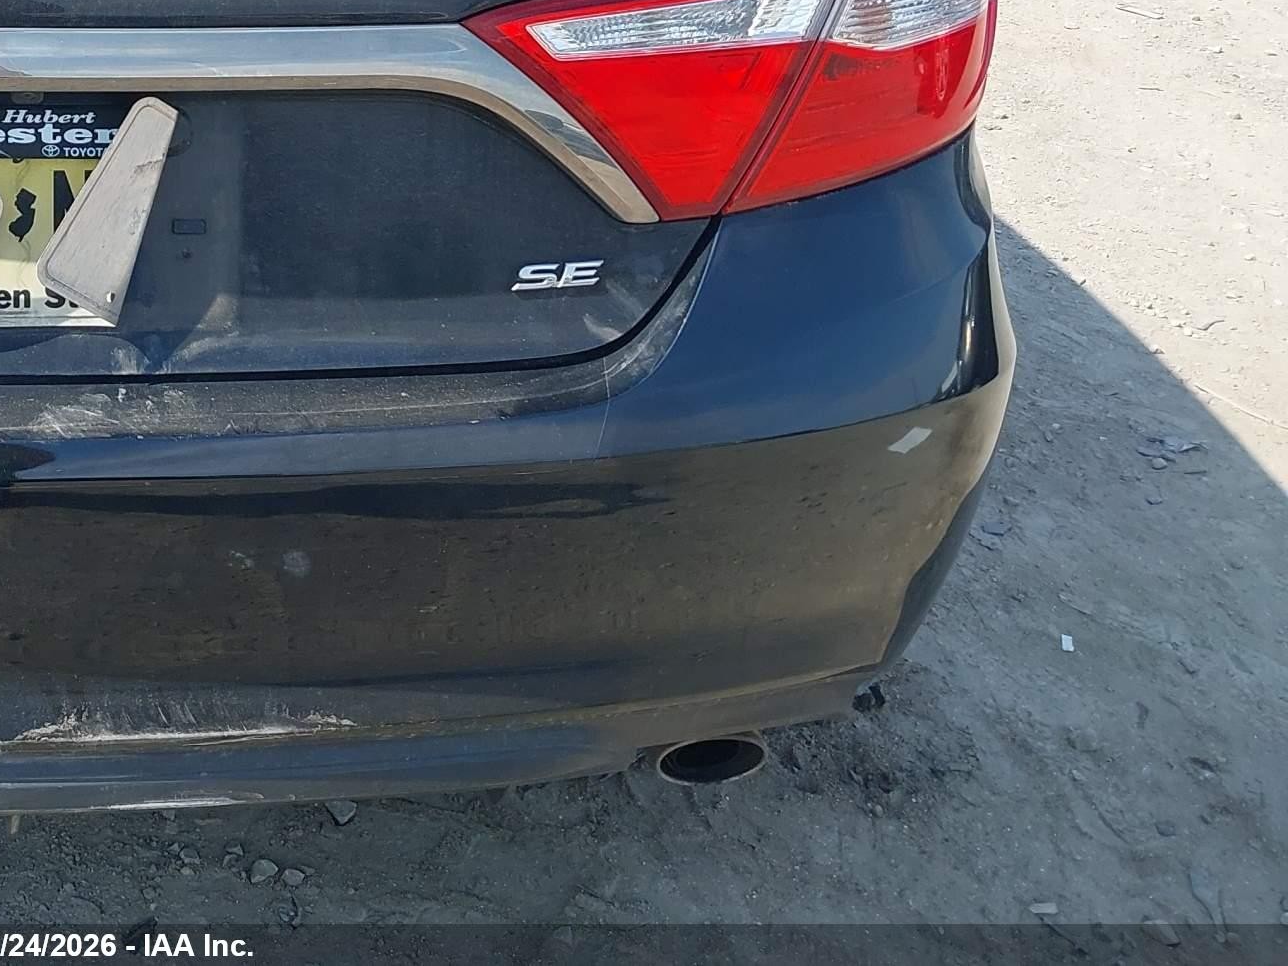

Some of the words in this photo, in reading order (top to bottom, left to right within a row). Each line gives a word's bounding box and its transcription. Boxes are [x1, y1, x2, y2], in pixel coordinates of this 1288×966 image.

[2, 109, 97, 124] Hubert
[63, 146, 108, 157] TOYOT
[510, 259, 605, 292] SE
